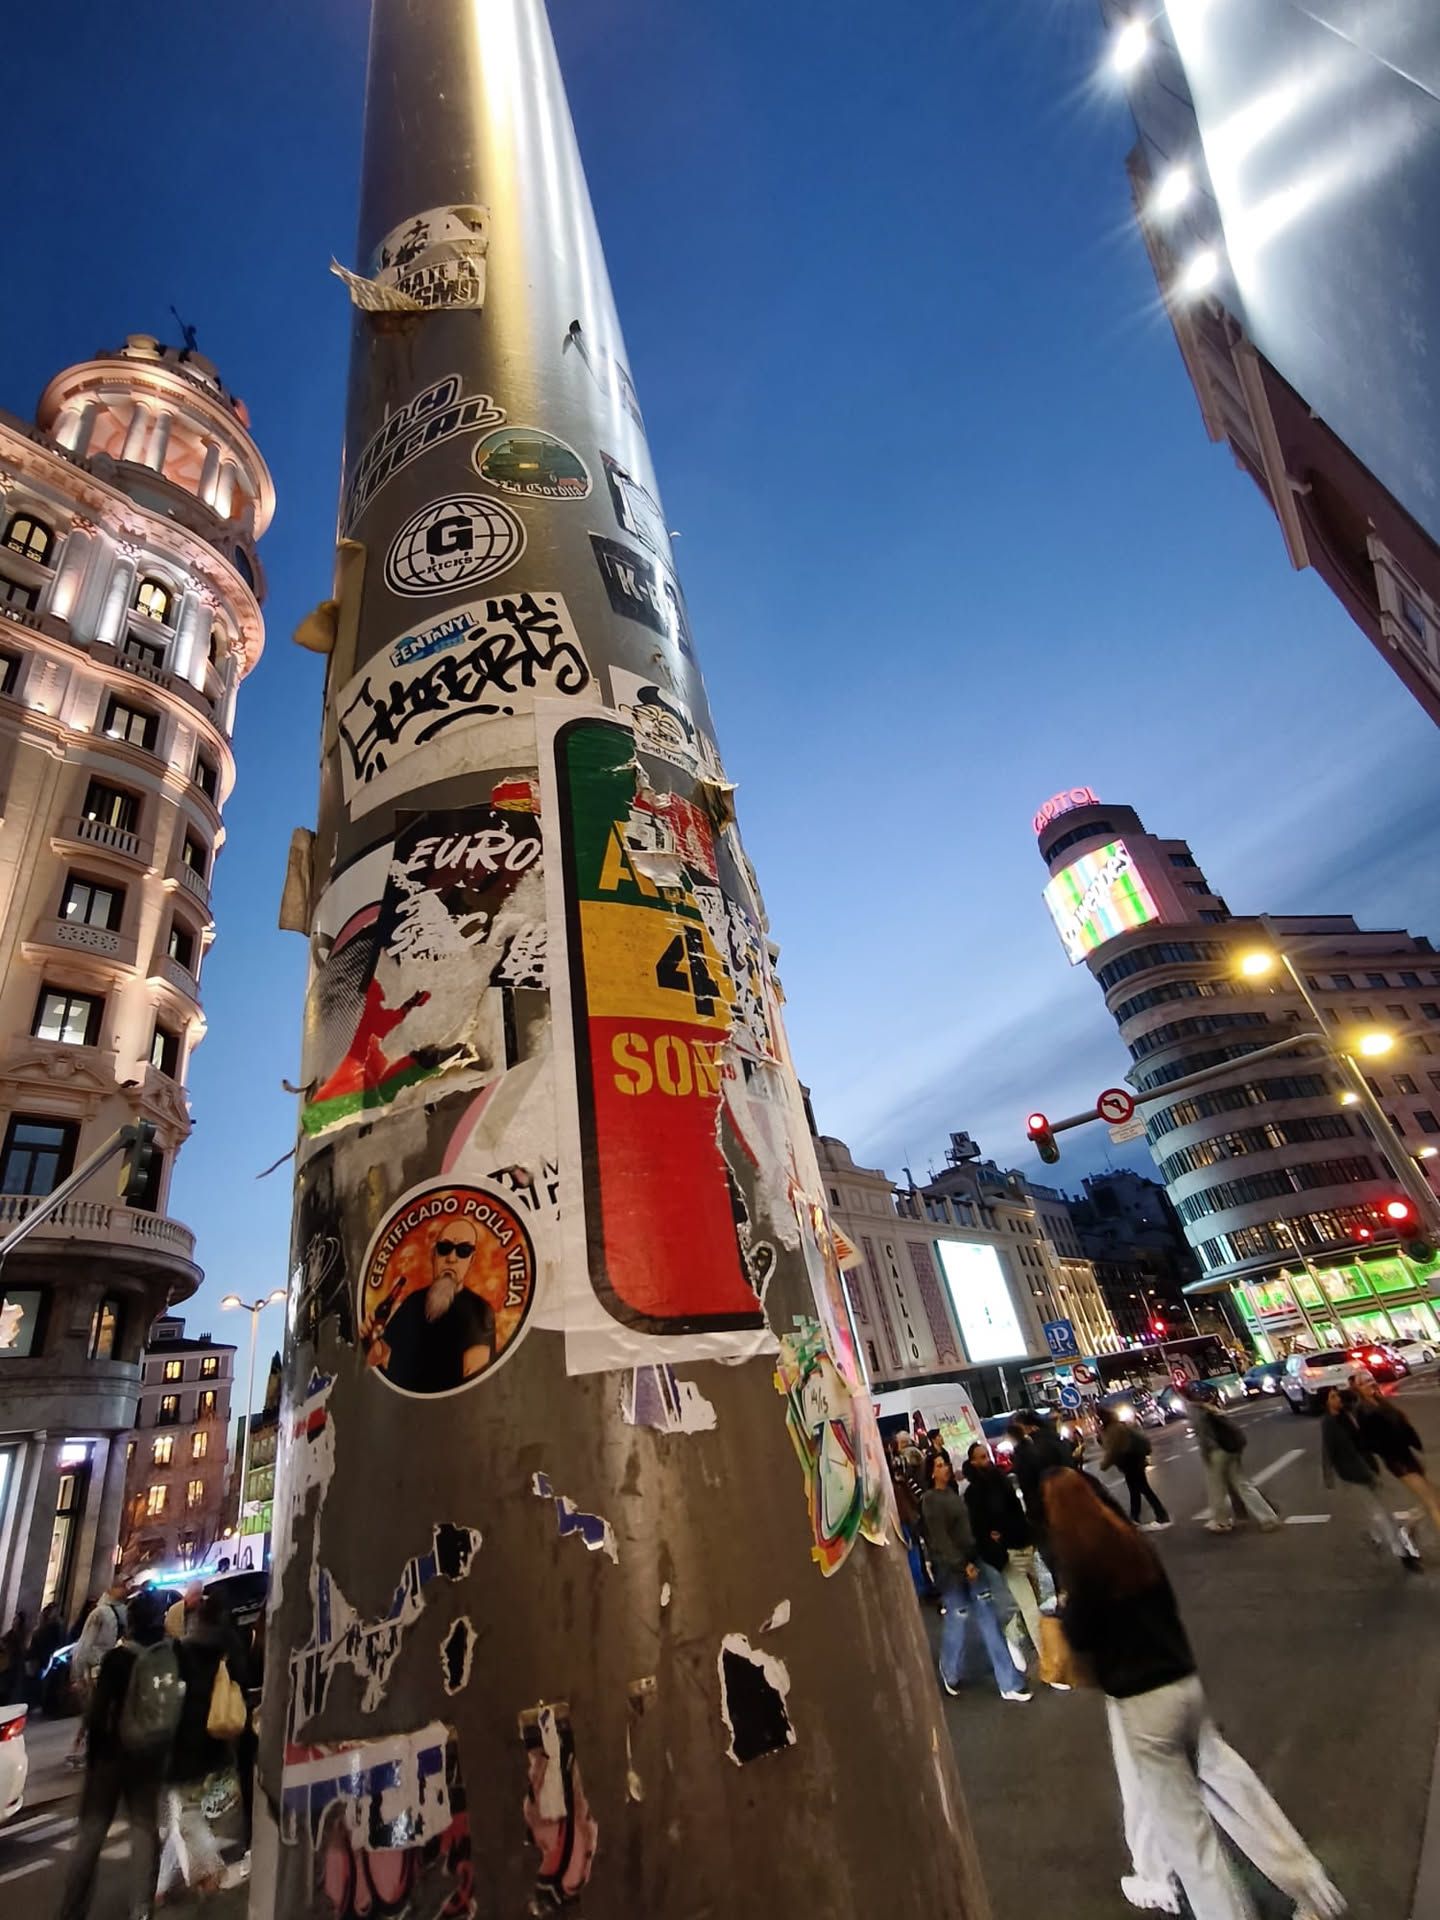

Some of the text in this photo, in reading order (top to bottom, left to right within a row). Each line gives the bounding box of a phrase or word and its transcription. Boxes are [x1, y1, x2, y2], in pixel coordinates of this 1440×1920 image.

[427, 515, 473, 556] G
[426, 556, 473, 574] KICKS
[390, 612, 479, 667] FENTANYL
[1033, 787, 1100, 834] CAPITOL
[407, 829, 541, 875] EURO
[370, 1197, 527, 1308] CERTIFICADO POLLA VIEJA
[886, 1245, 919, 1359] CALLAO
